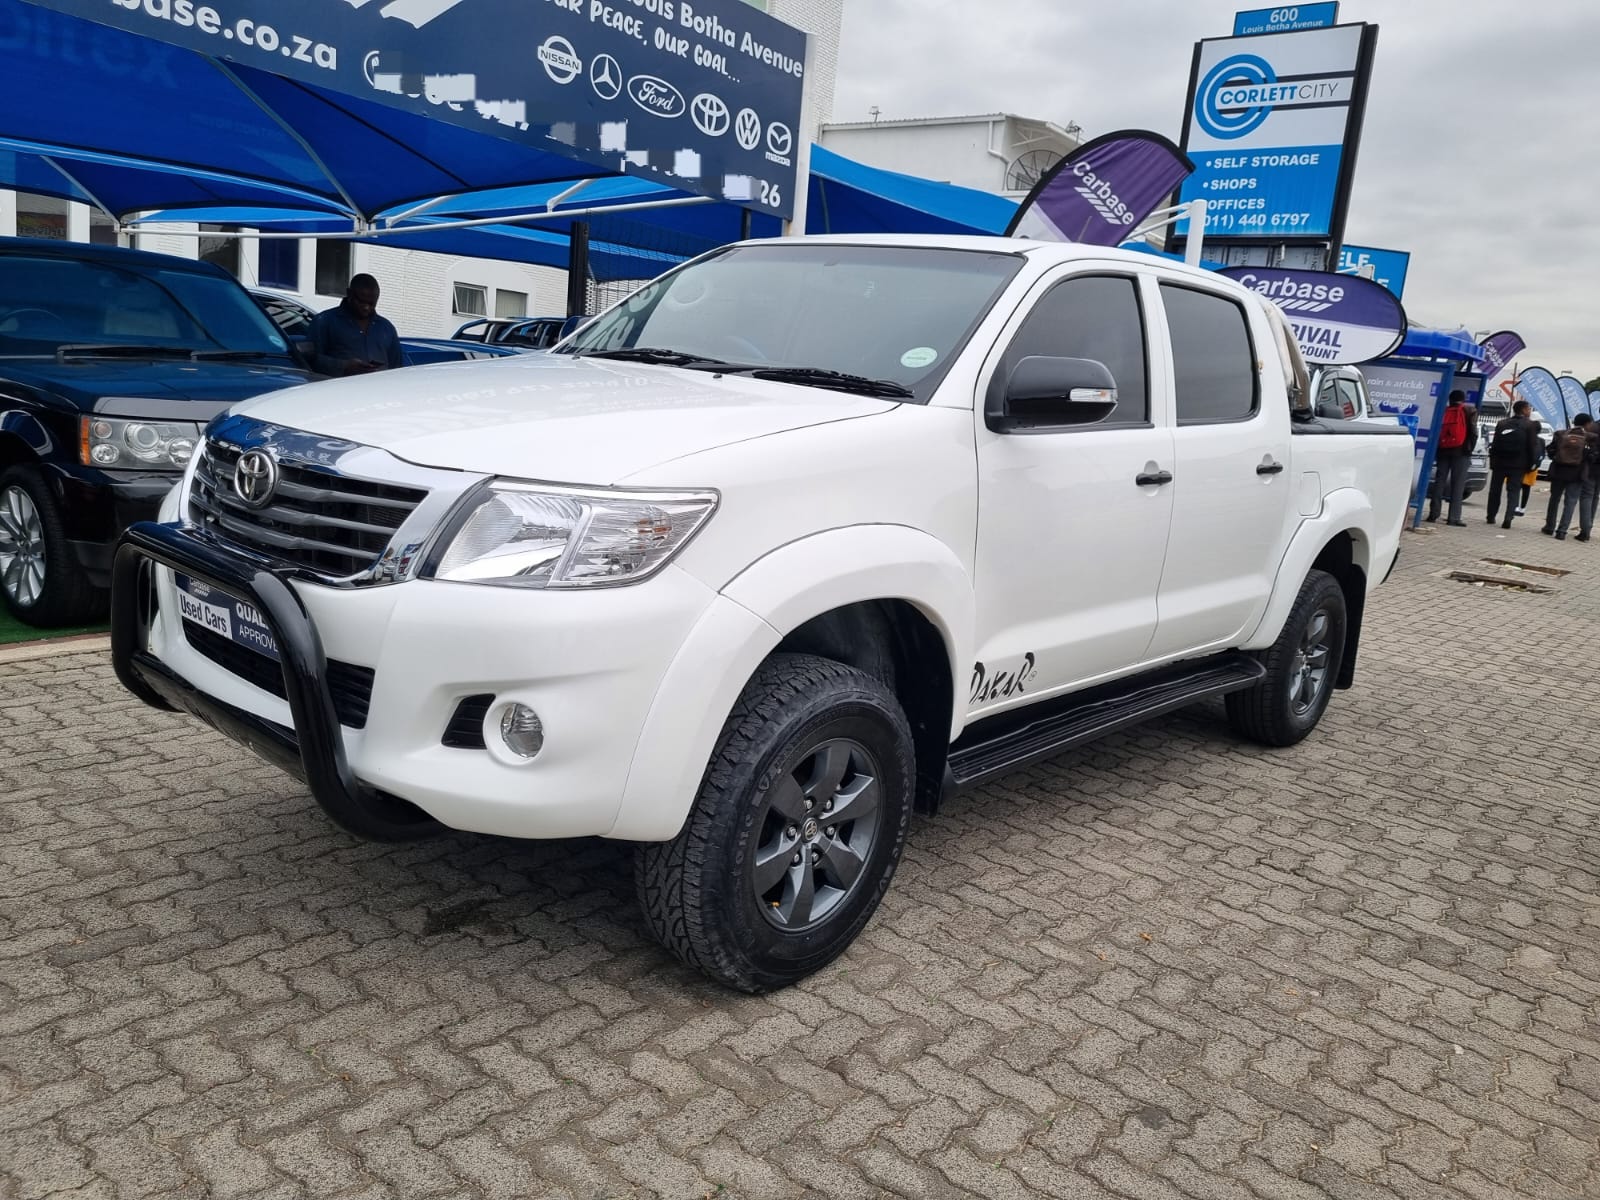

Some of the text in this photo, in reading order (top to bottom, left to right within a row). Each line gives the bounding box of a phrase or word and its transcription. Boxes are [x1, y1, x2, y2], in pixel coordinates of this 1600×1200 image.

[1242, 20, 1324, 34] Louis Botha Avenue
[1270, 8, 1298, 23] 600
[546, 0, 582, 14] UR
[590, 0, 648, 46] PEACE,
[654, 26, 690, 58] OUR
[680, 2, 735, 48] Botha
[740, 32, 803, 78] Avenue
[540, 50, 579, 70] NISSAN
[638, 81, 676, 112] Ford
[1213, 154, 1320, 169] SELF STORAGE
[1073, 161, 1135, 225] Carbase
[1210, 178, 1257, 190] SHOPS
[1207, 198, 1265, 210] OFFICES
[1238, 213, 1267, 226] 440
[1270, 213, 1311, 226] 6797
[1239, 274, 1345, 302] Carbase
[180, 594, 228, 633] Used Cars
[236, 602, 270, 631] QUAL
